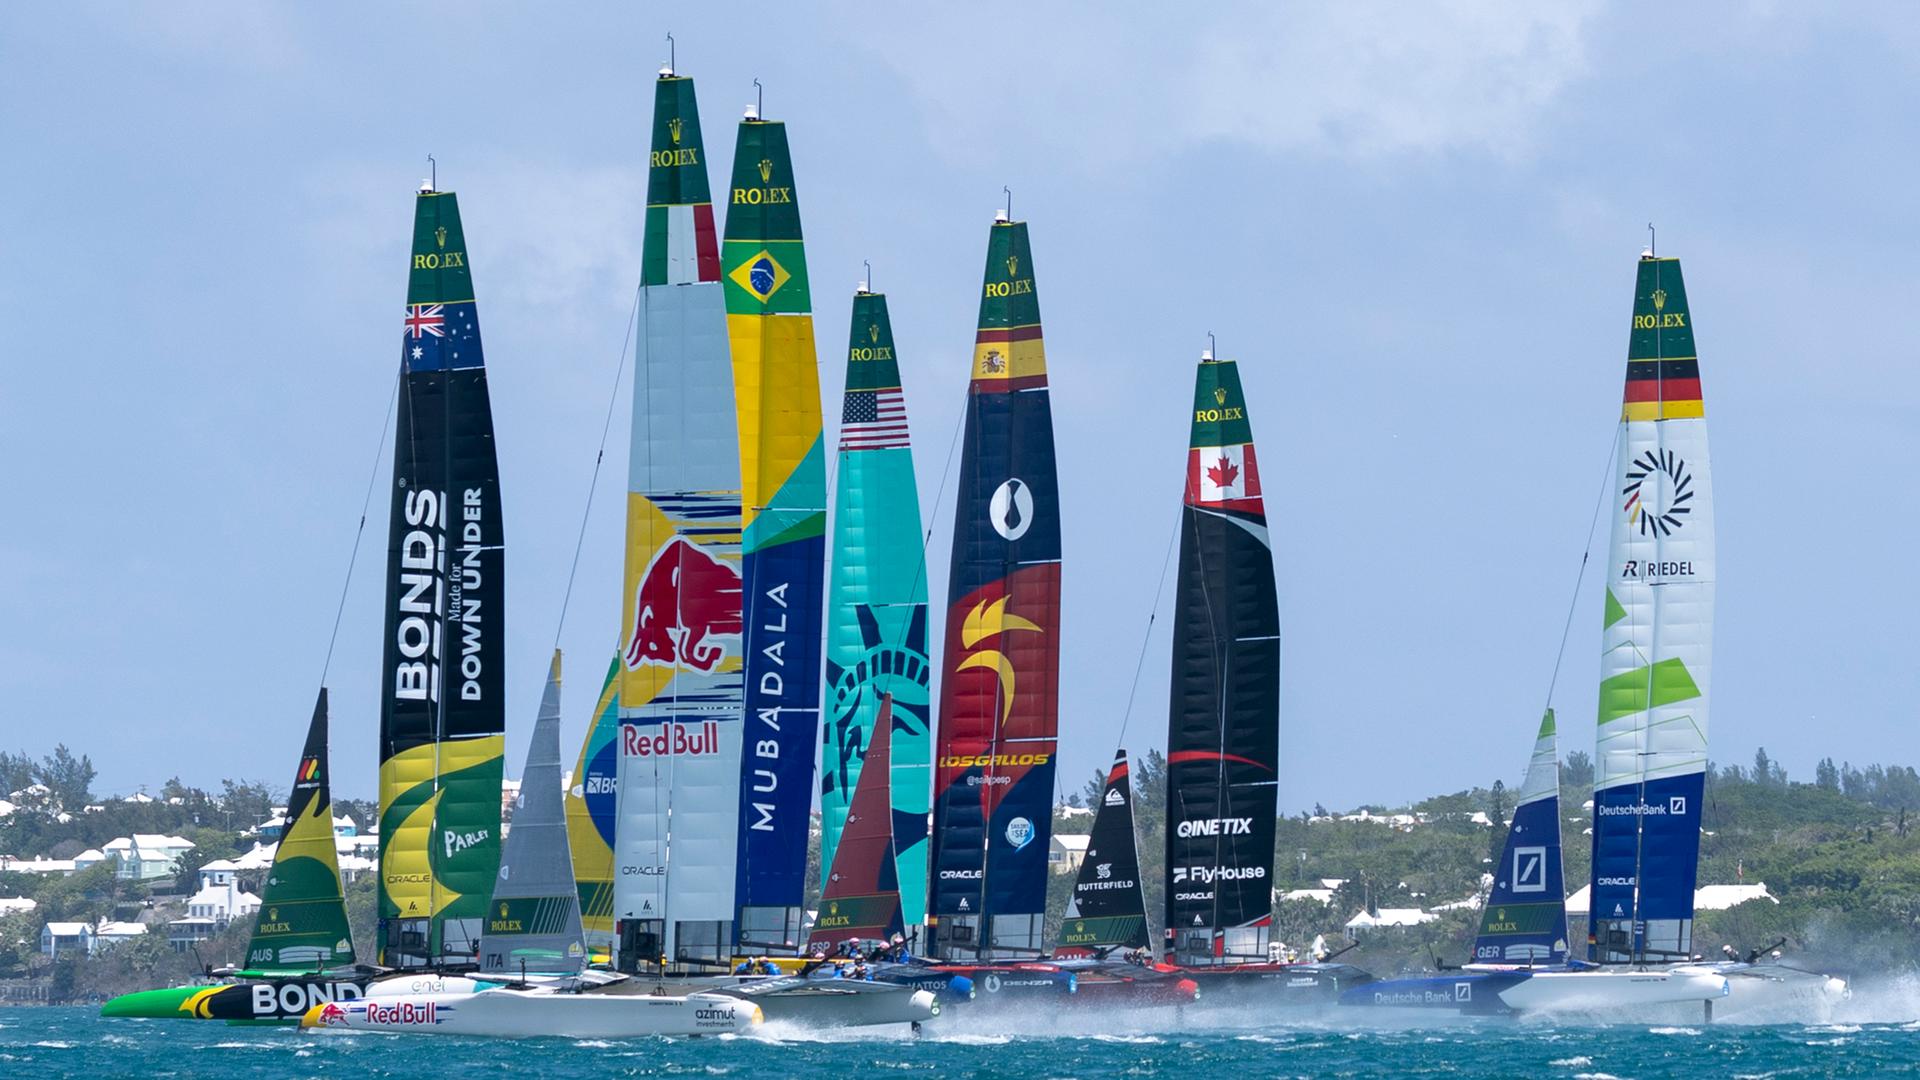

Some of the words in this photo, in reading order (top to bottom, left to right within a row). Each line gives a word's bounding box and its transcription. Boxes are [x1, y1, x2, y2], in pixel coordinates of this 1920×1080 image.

[650, 149, 698, 168] ROLEX
[732, 187, 790, 205] ROLEX
[414, 252, 464, 269] ROLEX
[985, 279, 1032, 297] ROLEX
[1633, 312, 1686, 330] ROLEX
[850, 347, 892, 361] ROLEX
[1196, 408, 1243, 422] ROLEX
[462, 488, 482, 590] UNDER
[448, 563, 461, 582] for
[1648, 561, 1695, 577] RIEDEL
[395, 489, 438, 700] BONDS
[448, 584, 461, 621] Made
[461, 599, 482, 701] DOWN
[751, 583, 789, 832] MUBADALA
[623, 723, 670, 757] Red
[673, 721, 718, 755] Bull
[1599, 804, 1640, 816] Deutsche
[1642, 804, 1667, 815] Bank
[1177, 817, 1253, 838] QINETIX
[444, 829, 489, 858] PARLEY
[387, 874, 431, 884] ORACLE
[622, 866, 665, 876] ORACLE
[940, 870, 982, 879] ORACLE
[1191, 866, 1265, 884] FlyHouse
[1078, 881, 1133, 891] BUTTERFIELD
[1597, 877, 1636, 886] ORACLE
[1175, 892, 1214, 901] ORACLE
[260, 922, 290, 934] ROLEX
[491, 920, 522, 931] ROLEX
[820, 916, 849, 927] ROLEX
[1488, 921, 1517, 933] ROLEX
[1066, 933, 1097, 943] ROLEX
[810, 941, 831, 953] ESP
[1477, 946, 1500, 958] GER
[250, 948, 273, 963] AUS
[486, 953, 504, 969] ITA
[411, 979, 446, 993] enel
[252, 982, 379, 1014] BOND
[1375, 992, 1423, 1004] Deutsche
[1425, 991, 1451, 1002] Bank
[366, 1002, 401, 1025] Red
[402, 1001, 437, 1025] Bull
[695, 1004, 736, 1020] azimut
